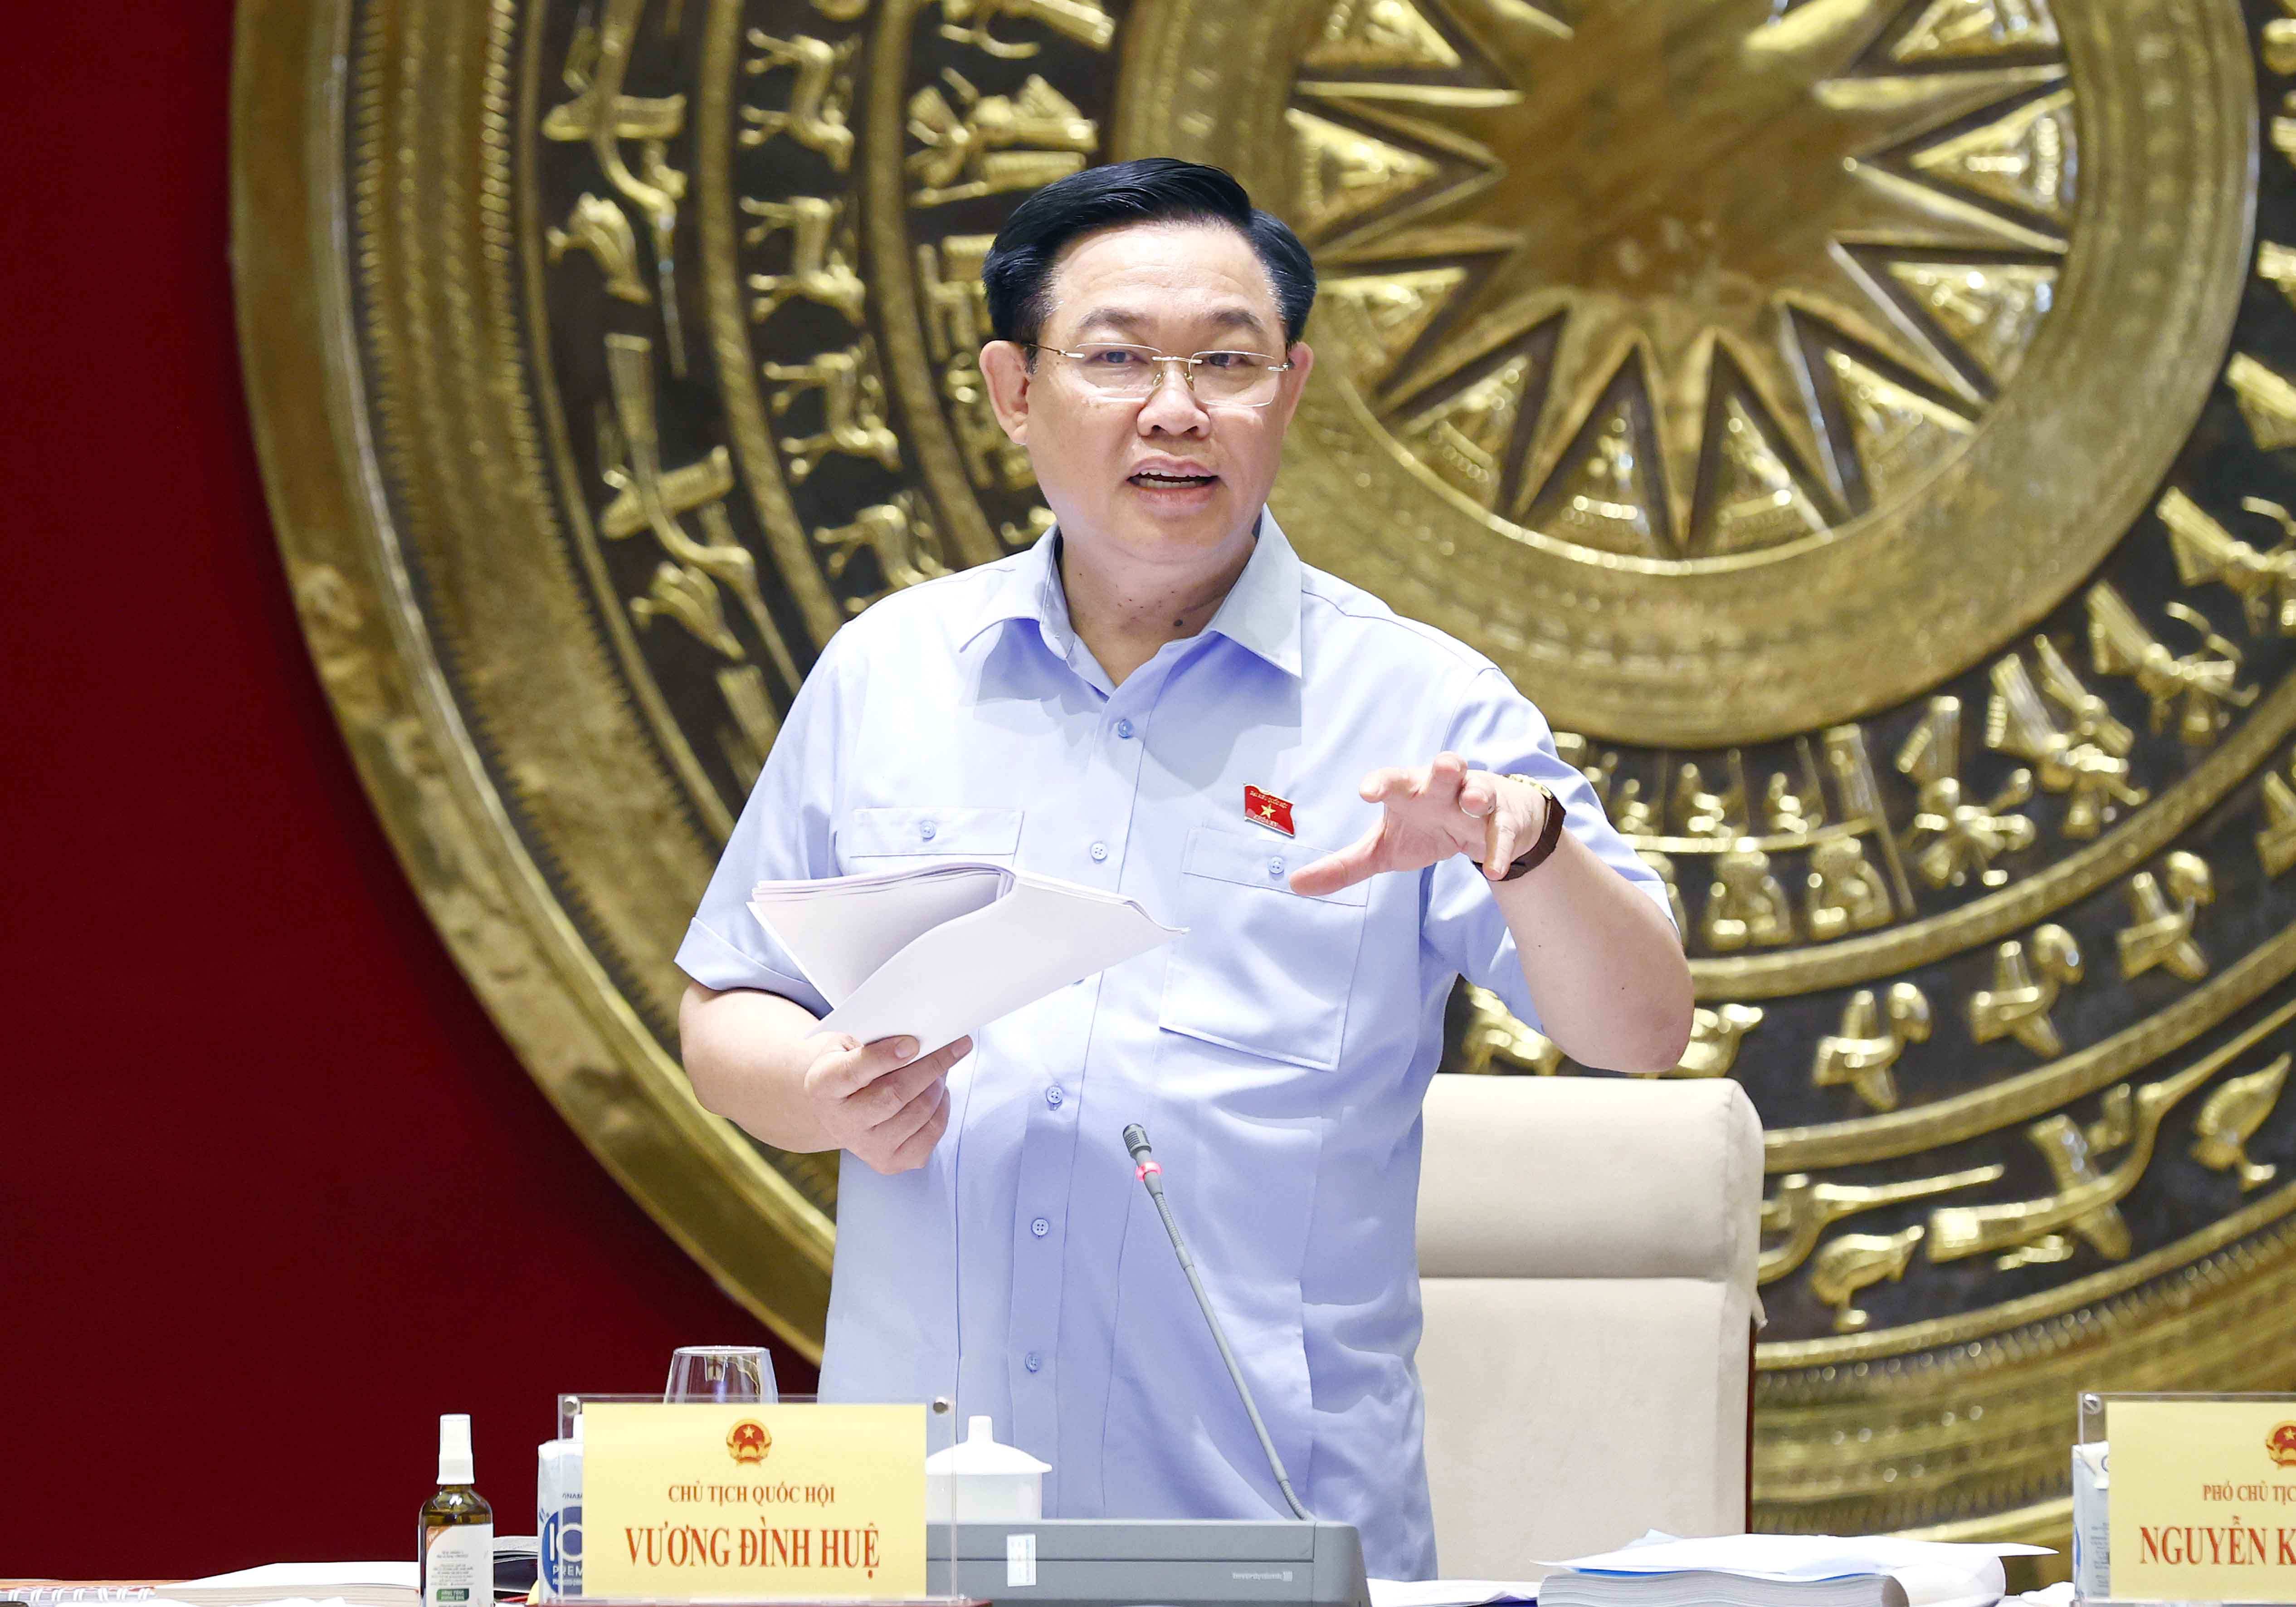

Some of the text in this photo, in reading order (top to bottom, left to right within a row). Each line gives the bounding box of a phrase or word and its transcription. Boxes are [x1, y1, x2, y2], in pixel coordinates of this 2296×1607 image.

[668, 1480, 834, 1507] CHỦ TỊCH QUỐC HỘI
[2203, 1480, 2233, 1501] PHÓ
[2237, 1480, 2268, 1502] CHỦ
[624, 1516, 880, 1579] VƯƠNG ĐÌNH HUỆ
[2140, 1515, 2268, 1565] NGUYỄN
